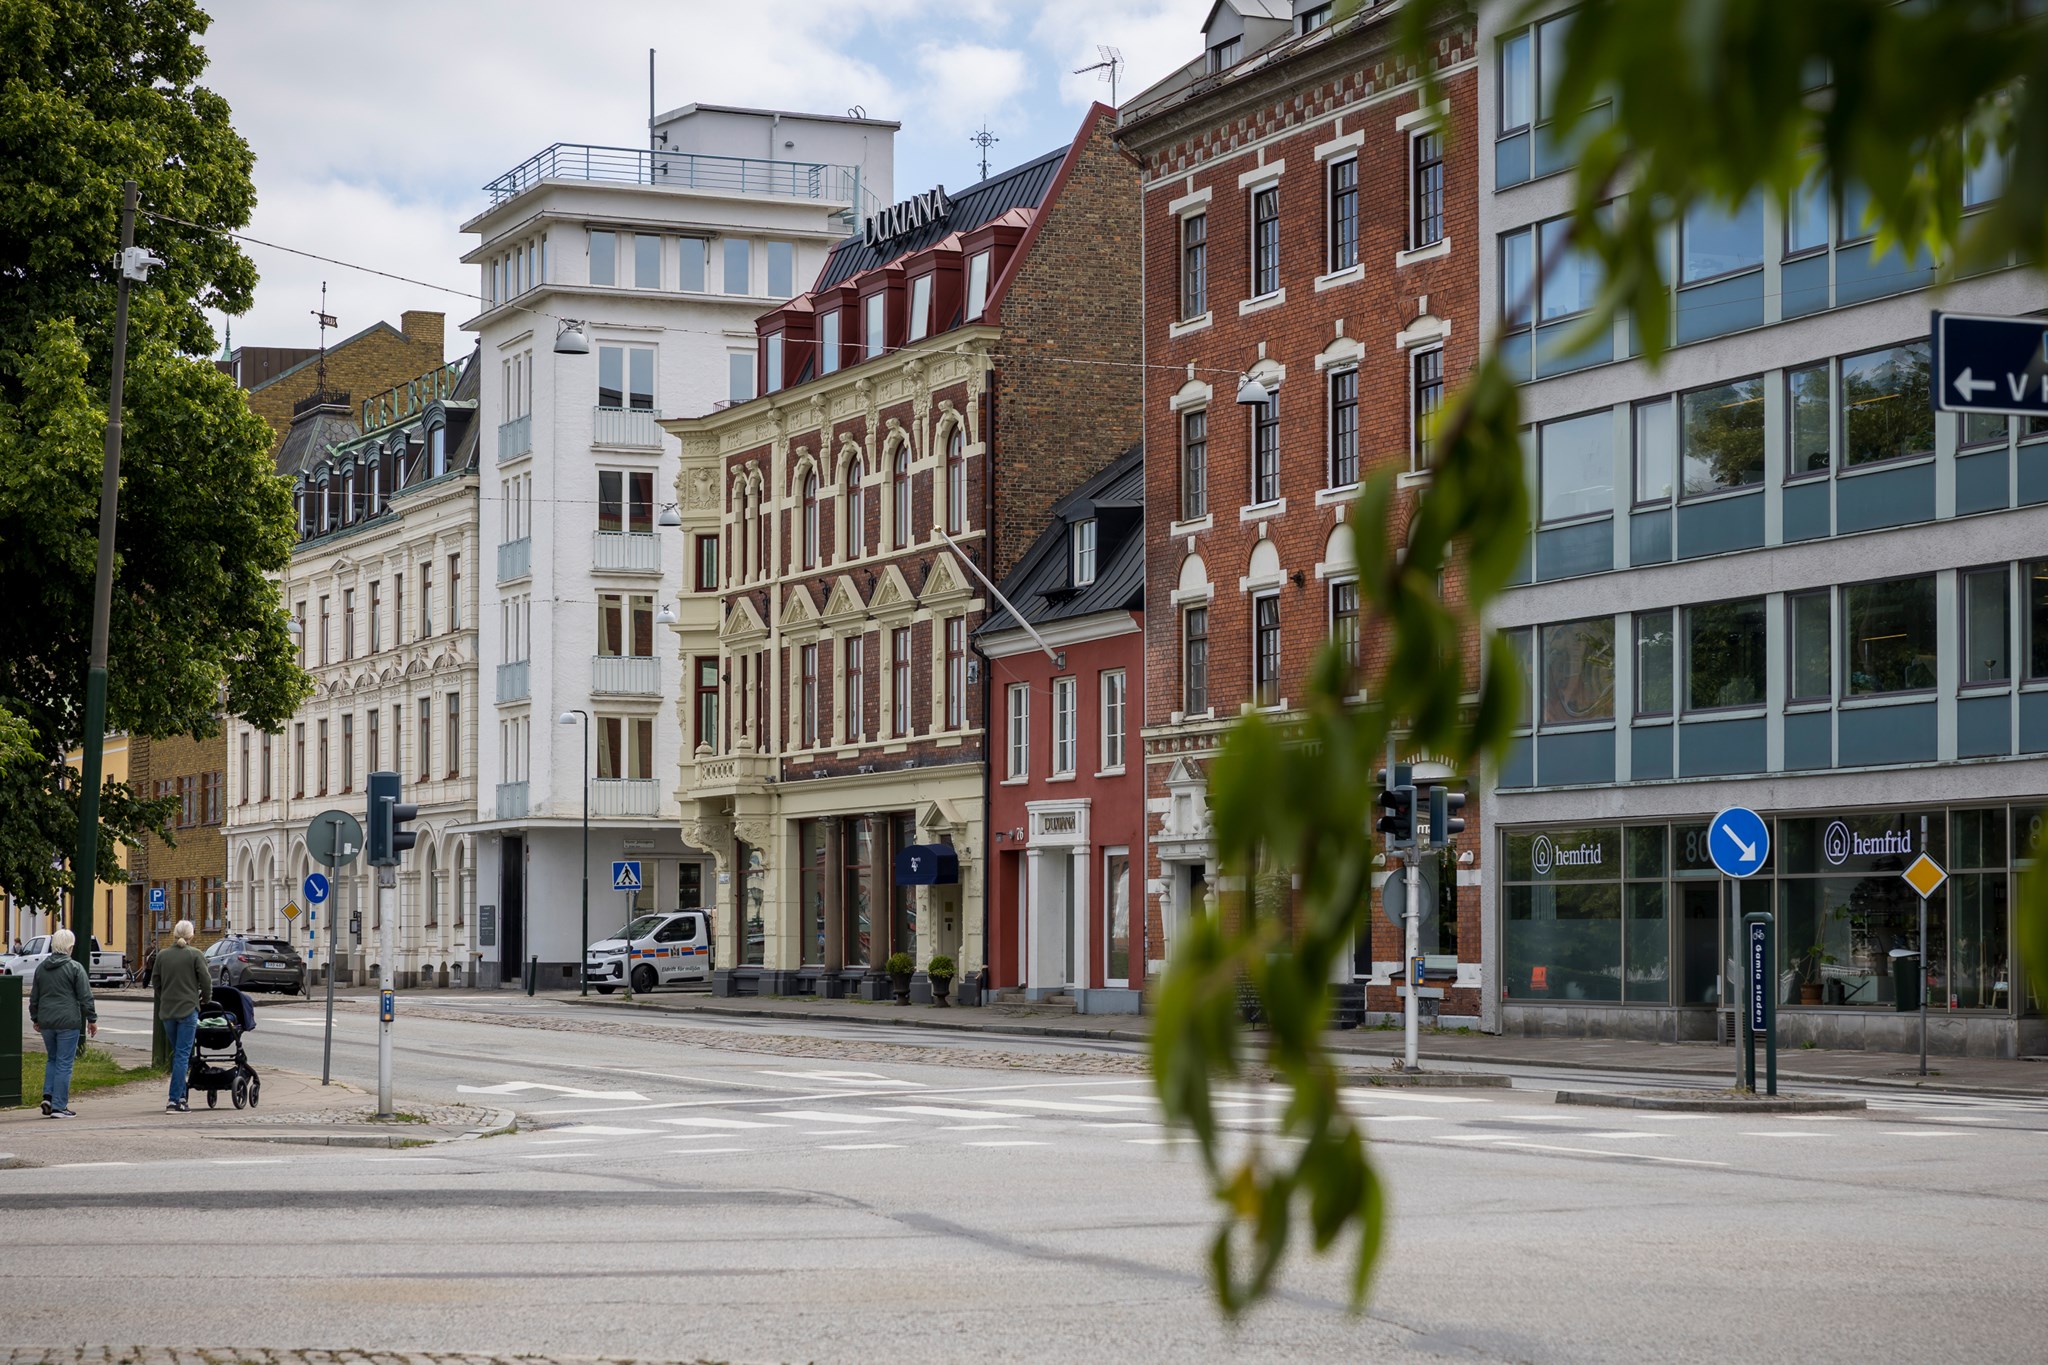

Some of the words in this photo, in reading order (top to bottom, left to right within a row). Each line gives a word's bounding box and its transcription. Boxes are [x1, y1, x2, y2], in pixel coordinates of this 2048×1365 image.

[864, 184, 949, 248] DUXIANA
[1016, 827, 1024, 841] 76
[1853, 829, 1912, 855] hemfrid
[1555, 843, 1602, 866] hemfrid
[153, 890, 162, 901] P
